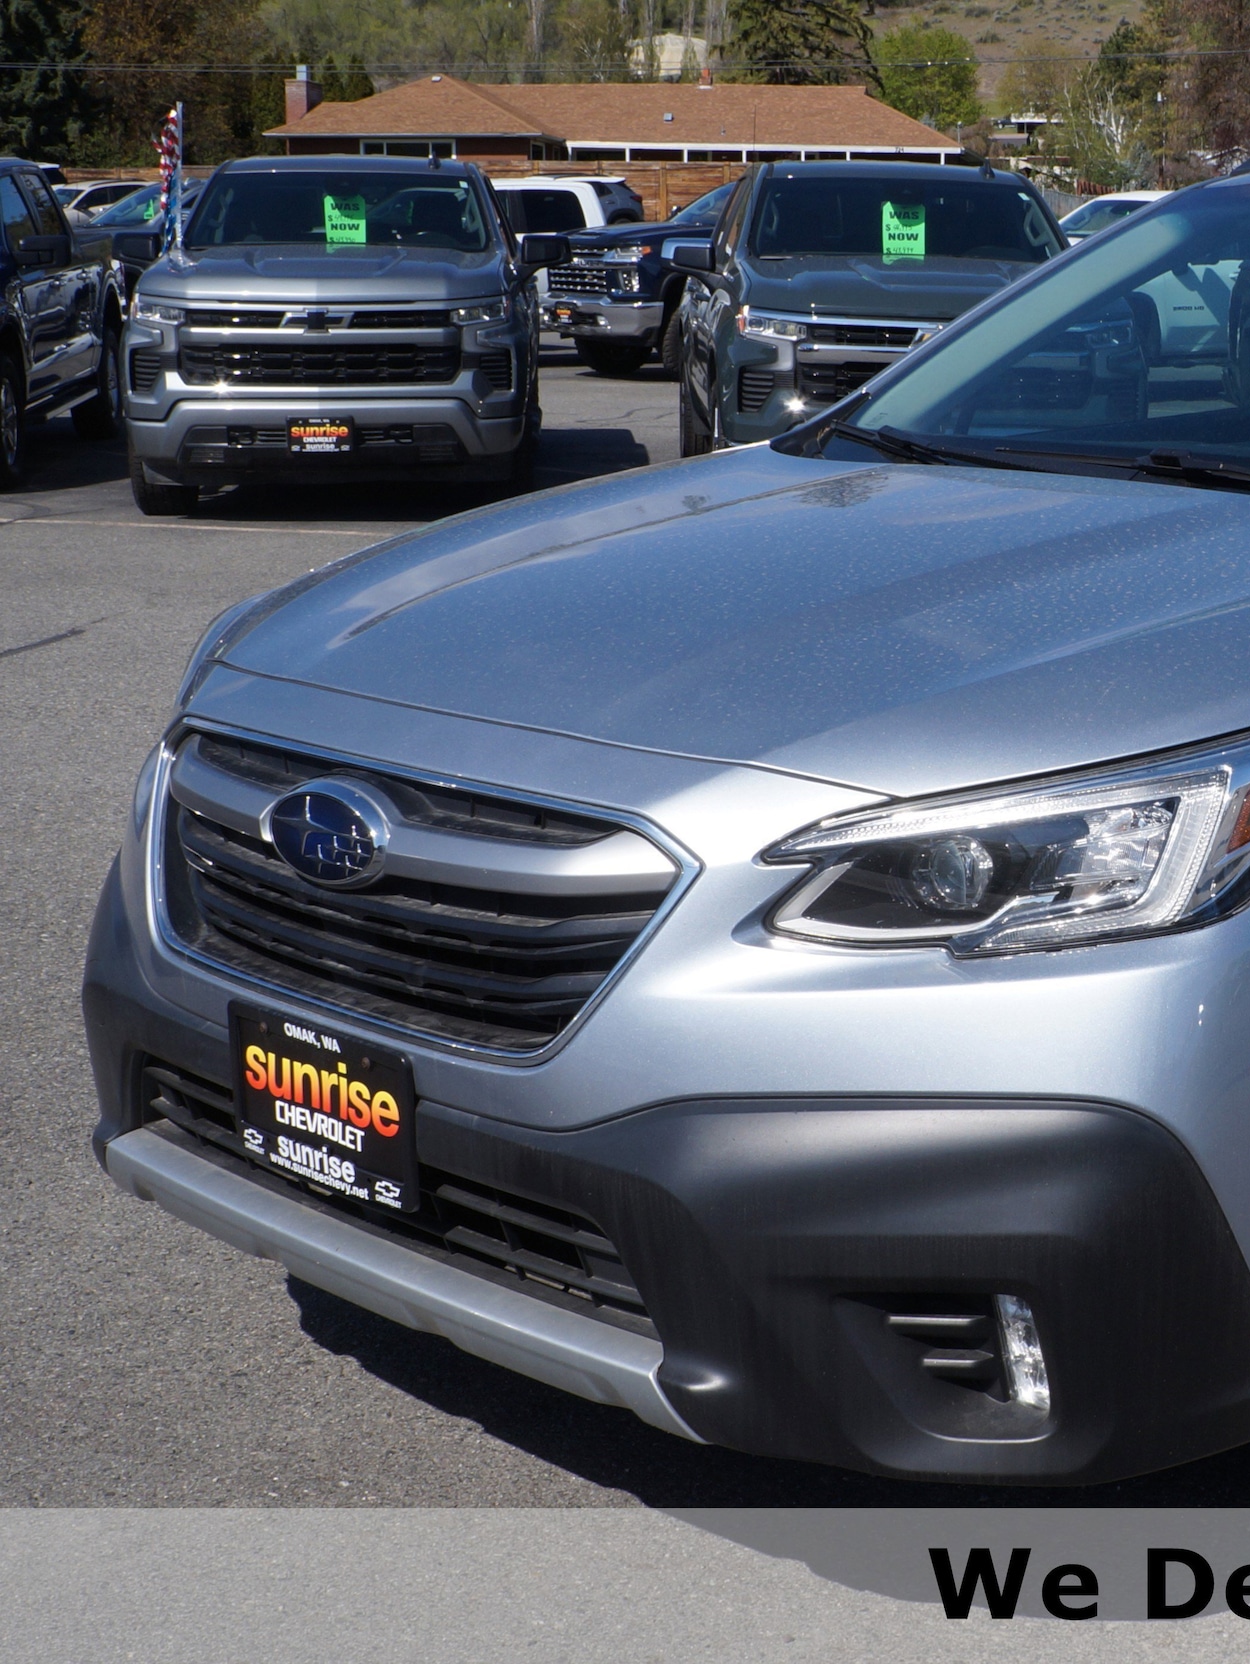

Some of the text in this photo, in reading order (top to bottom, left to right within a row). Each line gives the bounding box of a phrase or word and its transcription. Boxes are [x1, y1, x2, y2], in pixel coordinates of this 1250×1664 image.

[330, 202, 360, 211] WAS
[889, 211, 919, 220] WAS
[330, 223, 360, 231] NOW
[888, 232, 919, 241] NOW
[291, 423, 349, 437] sunrise
[283, 1022, 341, 1053] OMAK, WA
[245, 1045, 400, 1138] sunrise
[275, 1100, 365, 1152] CHEVROLET
[277, 1135, 356, 1184] sunrise
[269, 1153, 369, 1200] www.sunrisechevy.net
